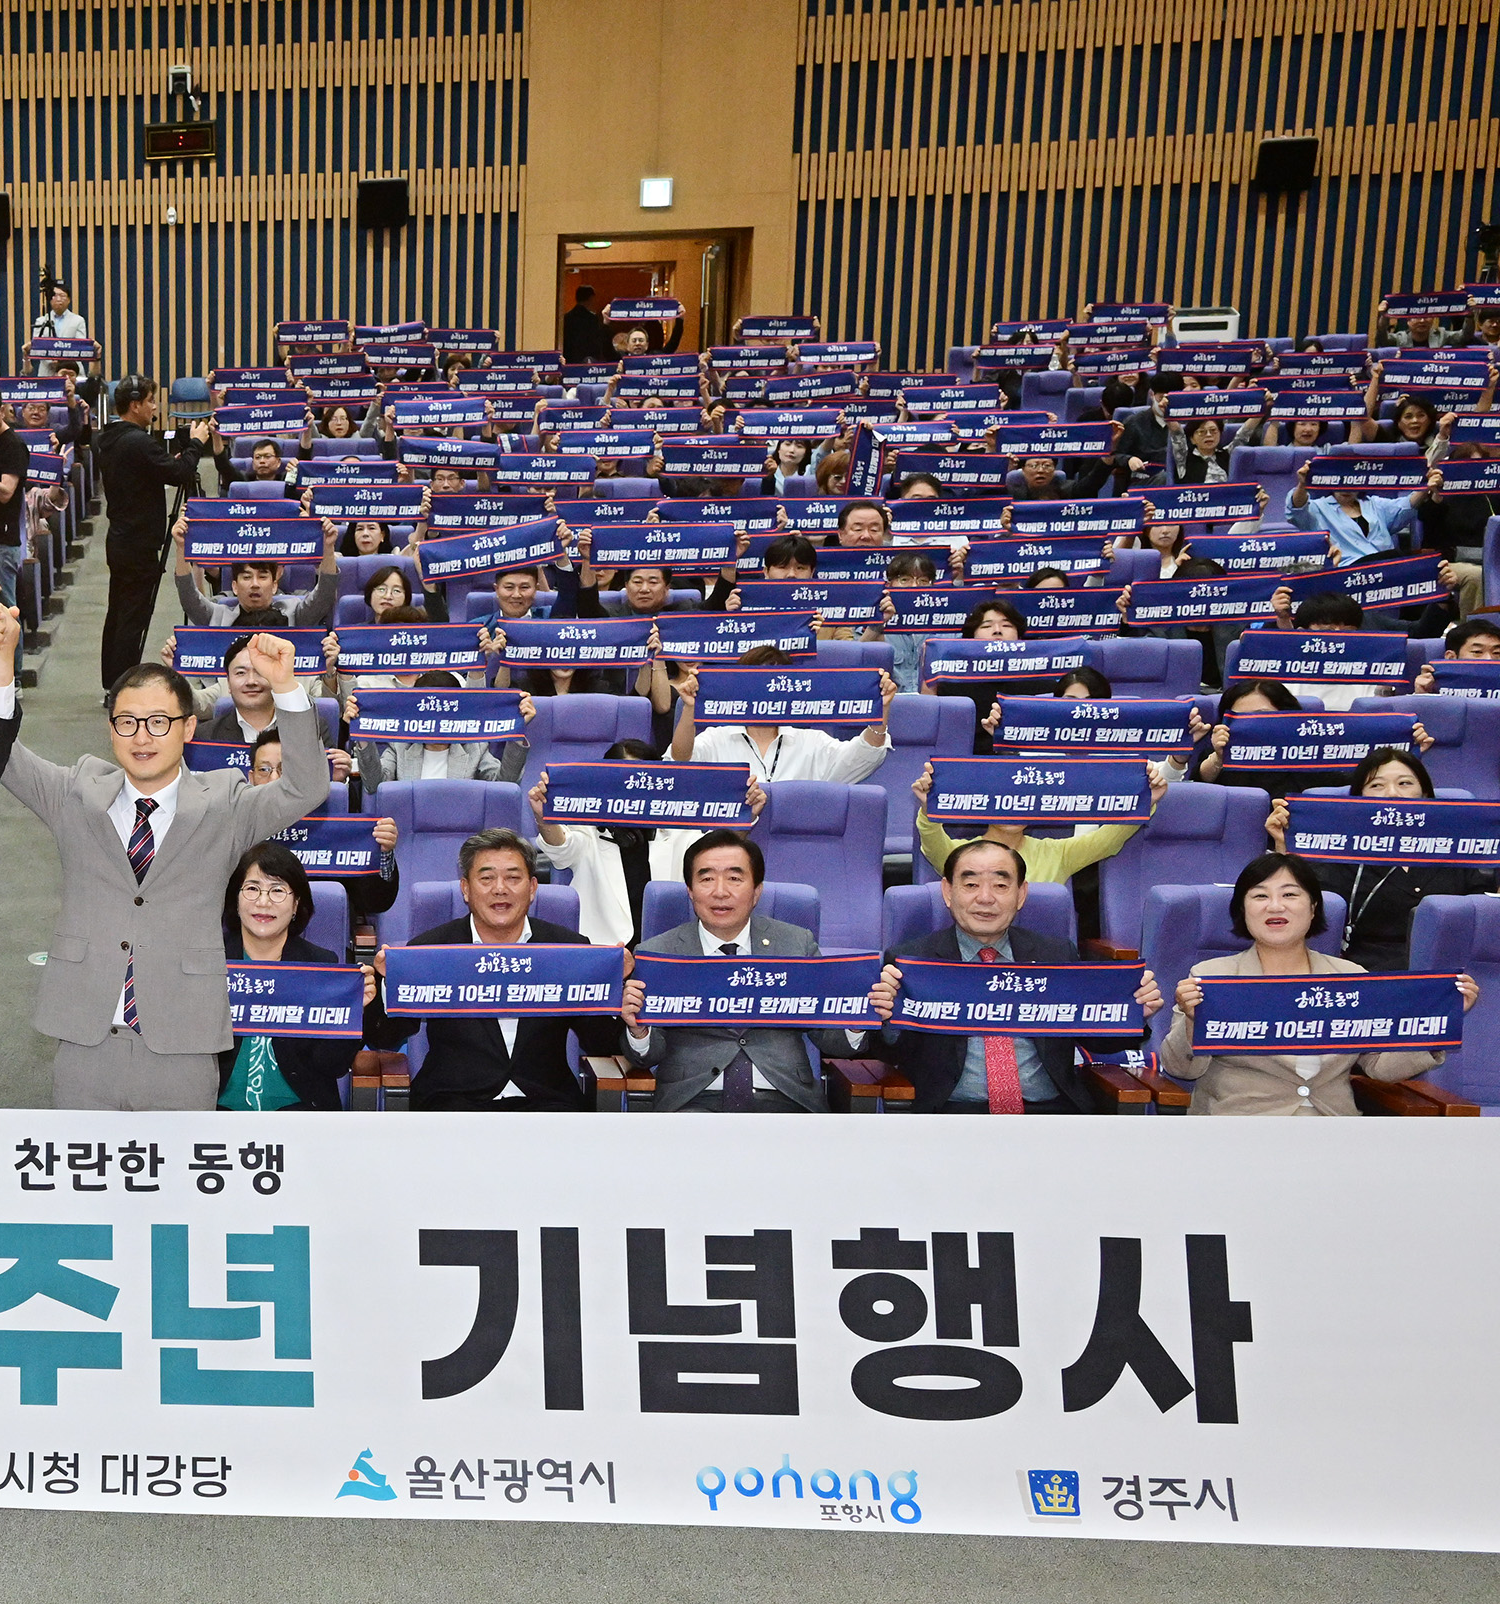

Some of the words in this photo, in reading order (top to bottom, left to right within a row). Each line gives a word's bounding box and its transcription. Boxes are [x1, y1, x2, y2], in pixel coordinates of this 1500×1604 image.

[1301, 638, 1345, 653] 해오름동맹
[338, 653, 374, 665] 함께한
[378, 653, 407, 665] 10년!
[410, 652, 447, 665] 함께할
[450, 651, 478, 663] 미래!
[1239, 659, 1281, 672] 함께한
[1286, 661, 1320, 673] 10년!
[1323, 661, 1367, 675] 함께할
[1370, 663, 1405, 675] 미래!
[767, 675, 811, 692] 해오름동맹
[704, 700, 748, 714] 함께한
[752, 701, 787, 714] 10년!
[791, 700, 835, 714] 함께할
[838, 700, 873, 714] 미래!
[1071, 702, 1119, 719] 해오름동맹
[359, 718, 400, 731] 함께한
[404, 720, 436, 732] 10년!
[440, 720, 481, 733] 함께할
[484, 719, 515, 733] 미래!
[1004, 727, 1050, 741] 함께한
[1055, 728, 1091, 741] 10년!
[1095, 728, 1143, 742] 함께할
[1146, 729, 1184, 742] 미래!
[624, 772, 674, 790] 해오름동맹
[1012, 766, 1065, 785] 해오름동맹
[553, 796, 602, 813] 함께한
[607, 799, 645, 814] 10년!
[650, 800, 699, 816] 함께할
[702, 802, 742, 817] 미래!
[938, 794, 989, 810] 함께한
[995, 795, 1036, 810] 10년!
[1041, 795, 1094, 811] 함께할
[1097, 795, 1138, 811] 미래!
[1371, 807, 1425, 827] 해오름동맹
[1295, 833, 1347, 850] 함께한
[1353, 836, 1395, 851] 10년!
[1399, 837, 1453, 853] 함께할
[1457, 839, 1500, 854] 미래!
[475, 952, 532, 973] 해오름동맹
[728, 967, 787, 987] 해오름동맹
[986, 972, 1047, 992] 해오름동맹
[398, 985, 453, 1002] 함께한
[458, 985, 501, 1002] 10년!
[507, 984, 563, 1002] 함께할
[567, 984, 610, 1001] 미래!
[1295, 987, 1359, 1008] 해오름동맹
[249, 1004, 304, 1023] 함께할
[308, 1006, 351, 1024] 미래!
[645, 996, 702, 1013] 함께한
[709, 997, 754, 1013] 10년!
[760, 997, 819, 1014] 함께할
[823, 997, 869, 1014] 미래!
[902, 998, 961, 1020] 함께한
[967, 1003, 1013, 1021] 10년!
[1018, 1004, 1077, 1022] 함께할
[1082, 1004, 1128, 1022] 미래!
[1206, 1021, 1268, 1039] 함께한
[1275, 1020, 1324, 1038] 10년!
[1330, 1018, 1393, 1037] 함께할
[1398, 1016, 1448, 1035] 미래!
[14, 1138, 164, 1192] 찬란한
[189, 1142, 283, 1195] 동행
[419, 1227, 1253, 1424] 기념행사
[101, 1455, 231, 1497] 대강당
[406, 1456, 615, 1503] 울산광역시
[695, 1454, 922, 1525] pohang
[1102, 1475, 1238, 1521] 경주시
[820, 1504, 884, 1523] 포항시
